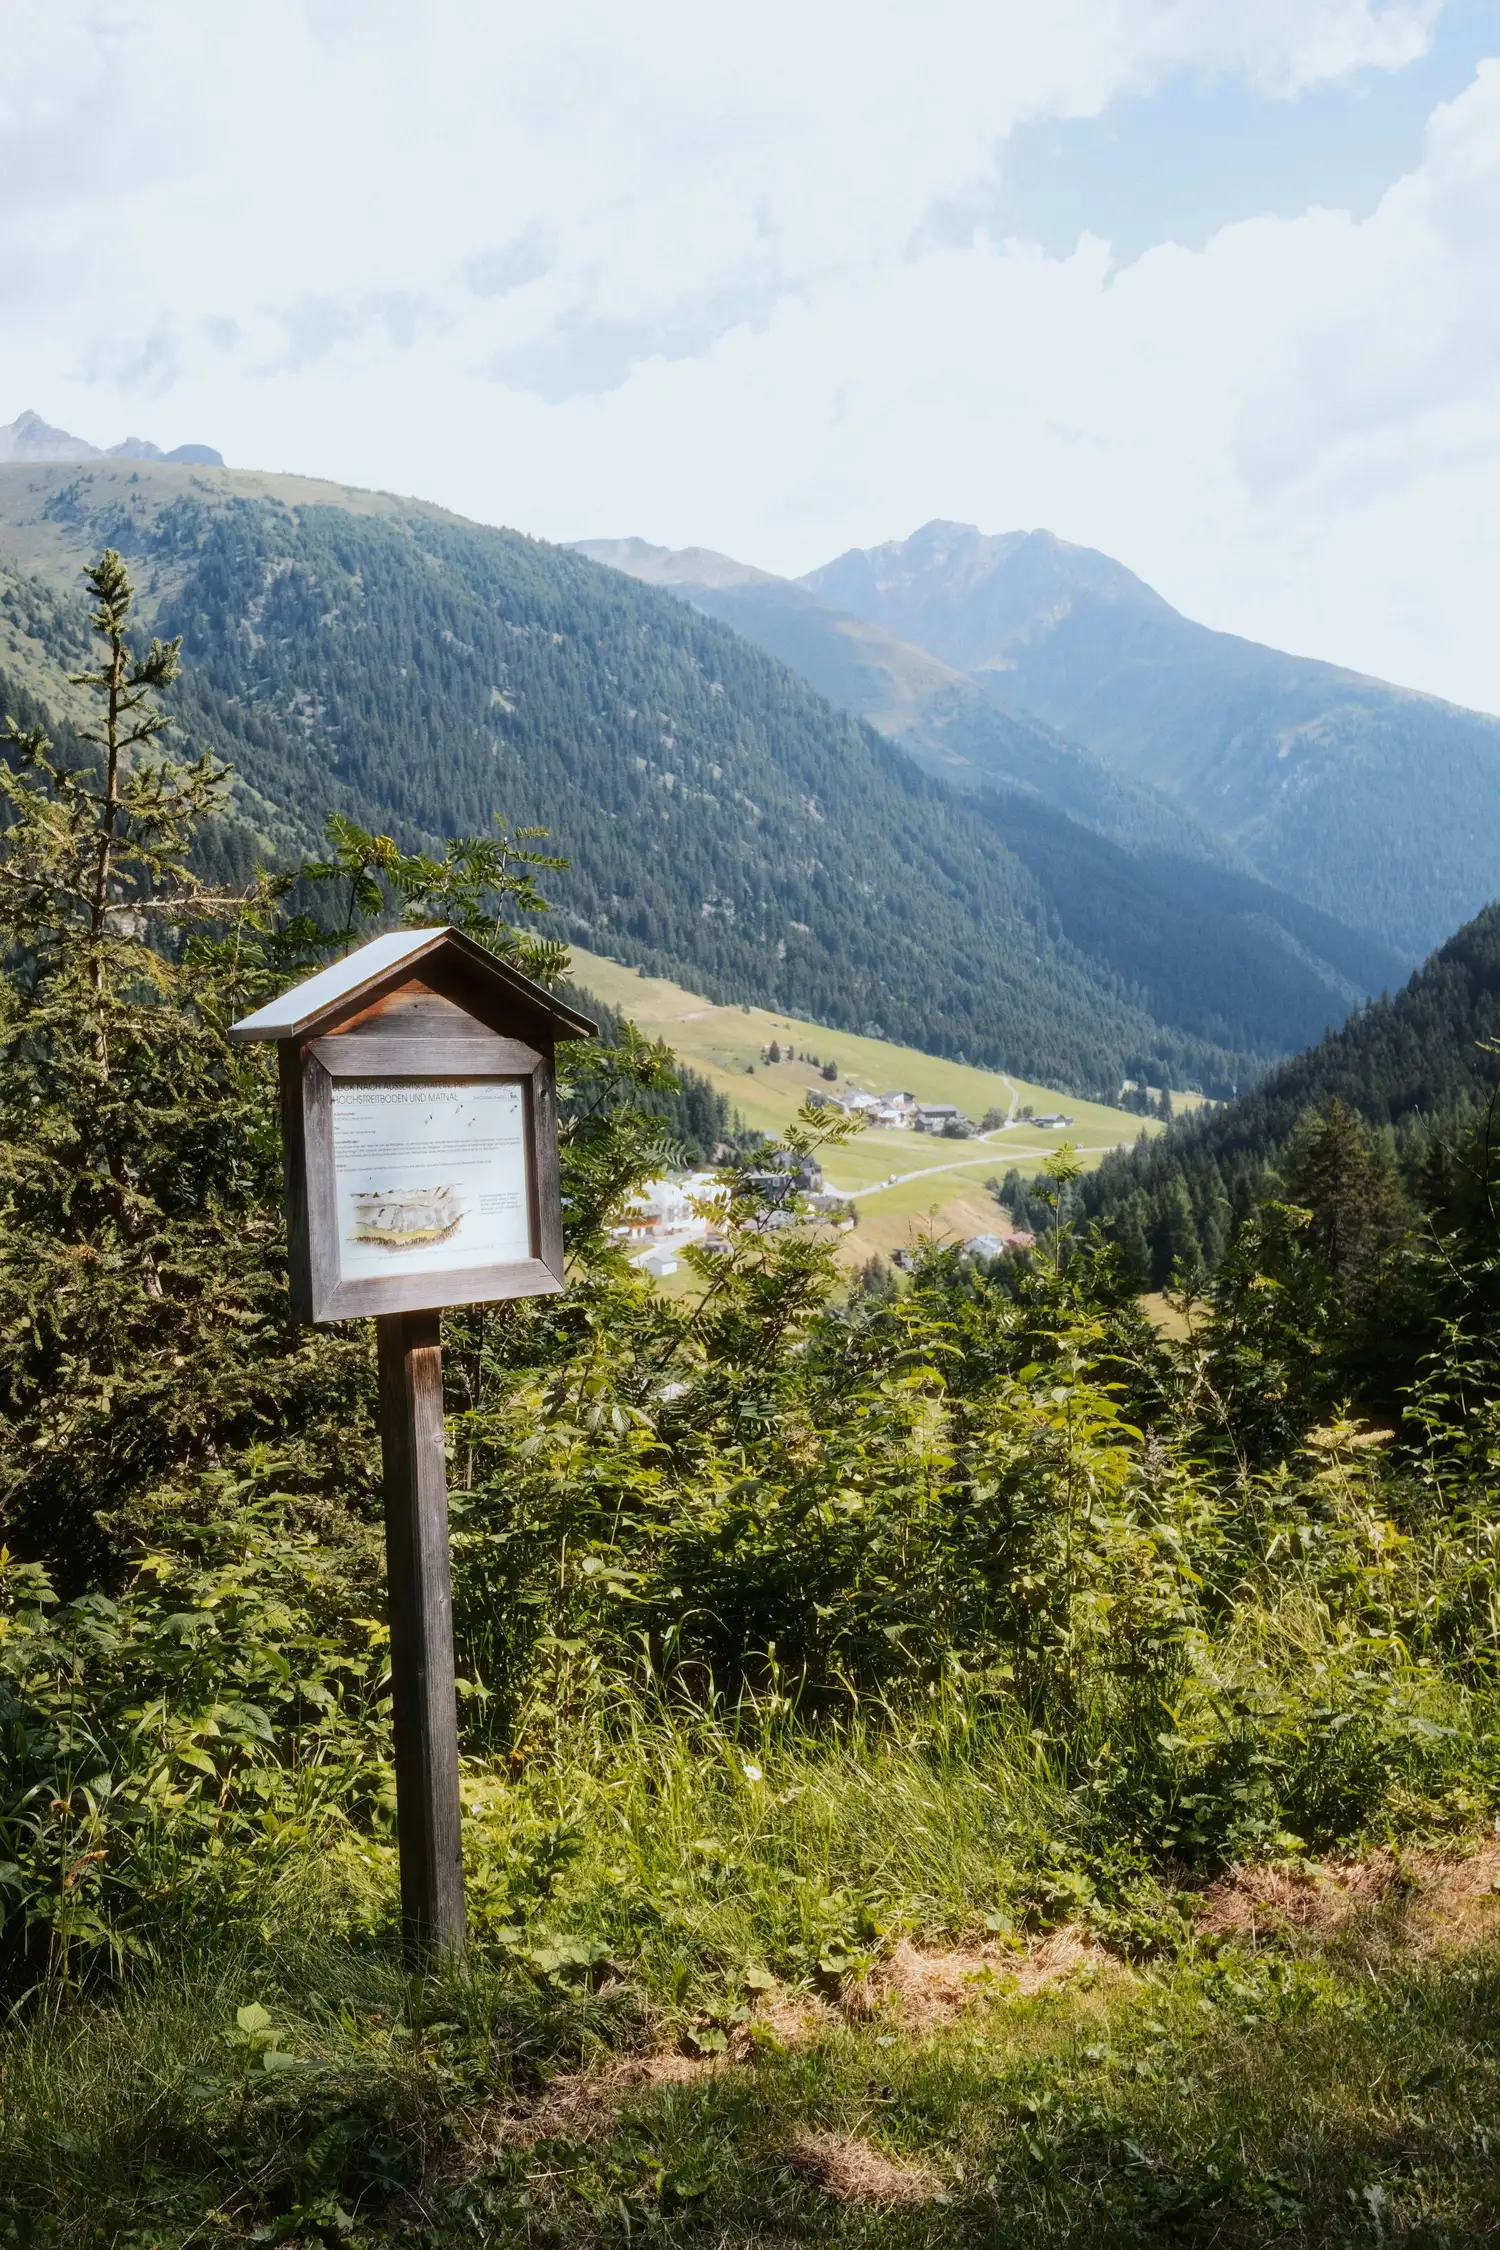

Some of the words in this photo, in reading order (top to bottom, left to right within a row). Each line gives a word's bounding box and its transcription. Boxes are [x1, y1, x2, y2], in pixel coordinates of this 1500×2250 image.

[332, 1082, 356, 1092] BLICK
[357, 1082, 381, 1092] NACH
[332, 1094, 408, 1105] HOCHSTREITBODEN
[410, 1093, 426, 1103] UND
[428, 1092, 459, 1102] MATNAL
